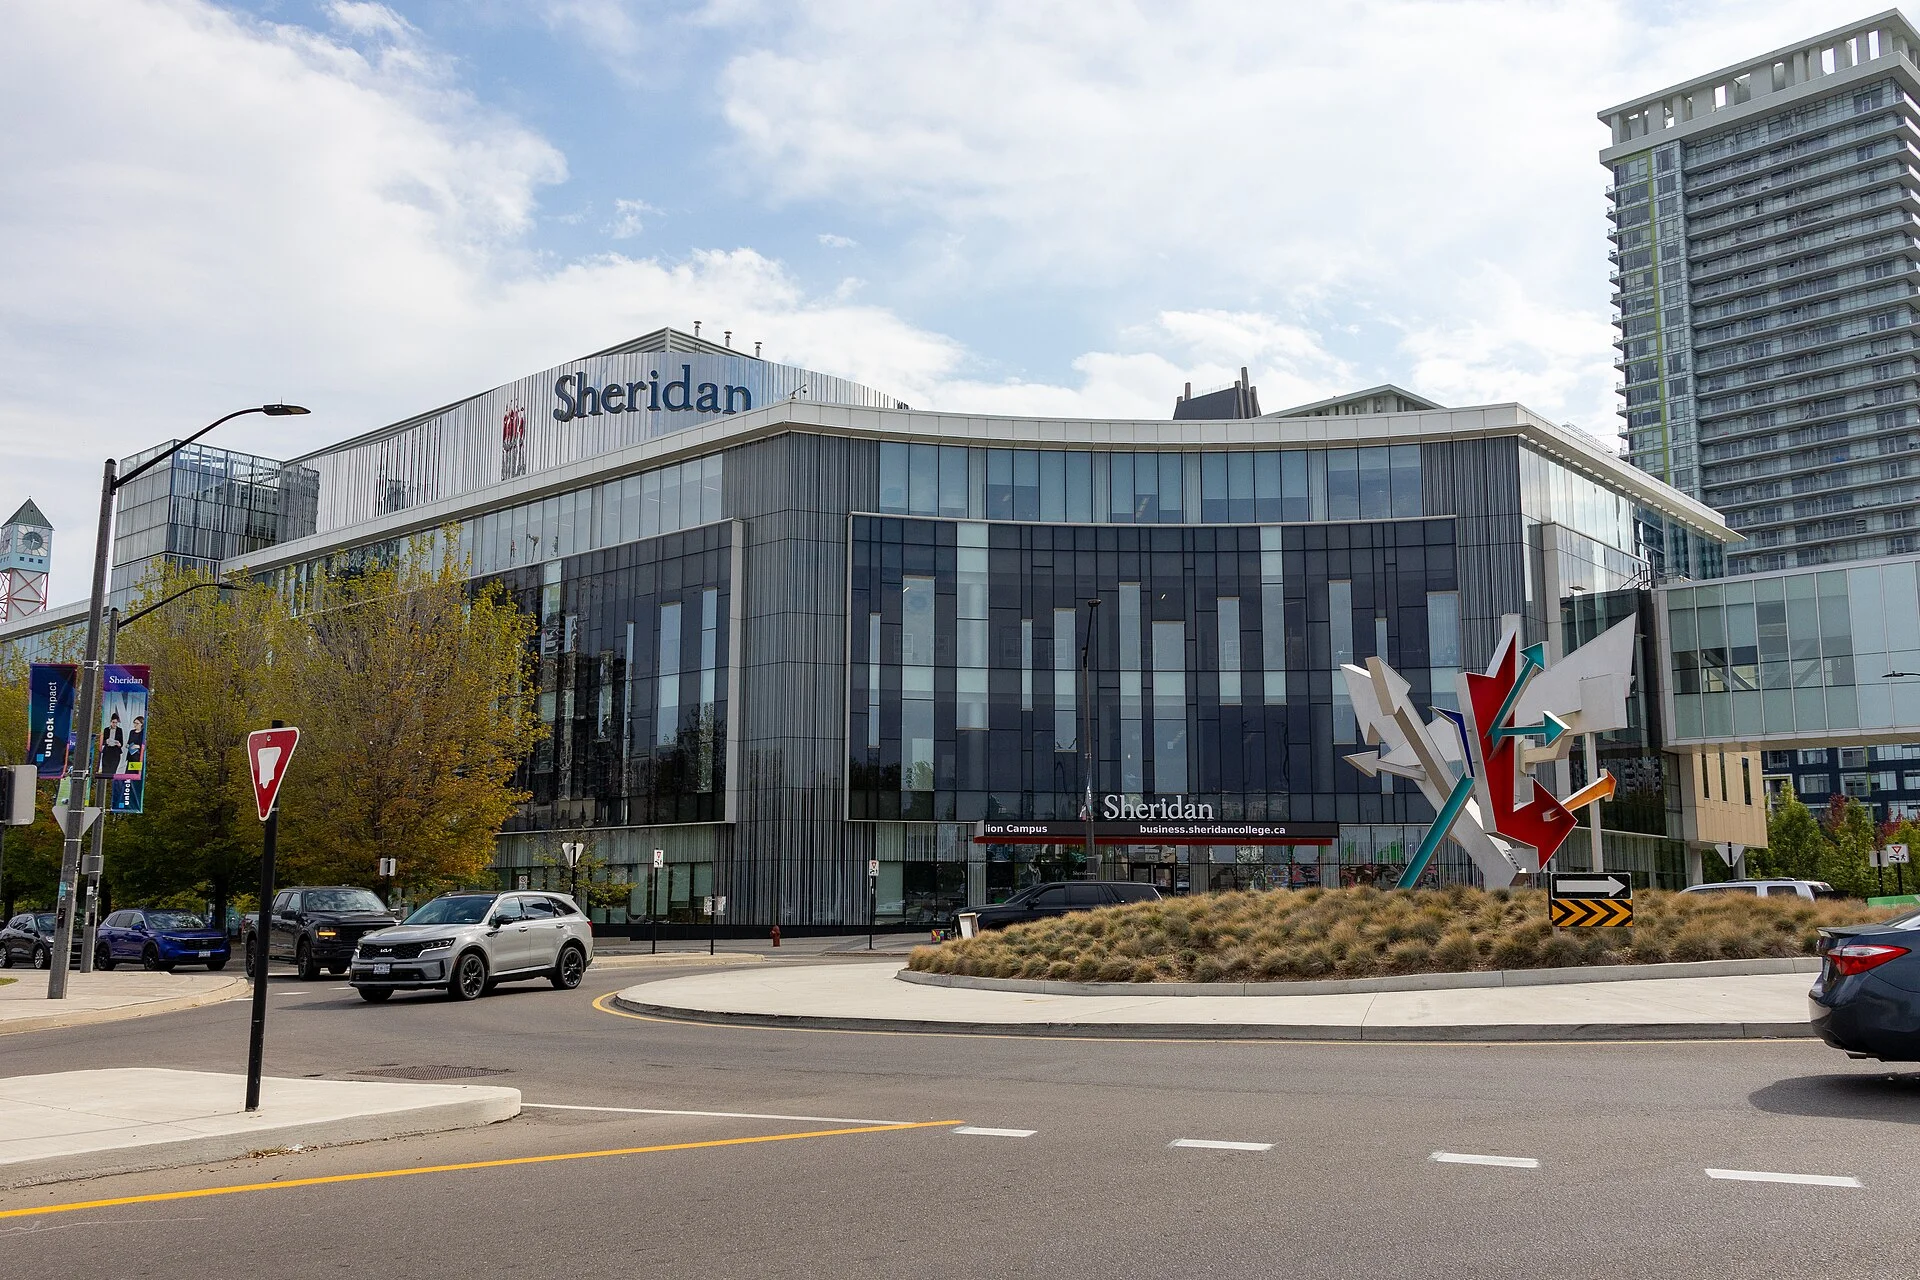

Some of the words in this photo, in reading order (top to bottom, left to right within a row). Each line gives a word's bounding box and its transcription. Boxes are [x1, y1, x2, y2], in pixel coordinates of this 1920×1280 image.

[553, 364, 752, 422] Sheridan
[109, 675, 143, 684] Sheridan
[47, 681, 58, 714] impact
[44, 717, 55, 758] unlock
[1103, 794, 1214, 819] Sheridan
[1006, 824, 1048, 835] Campus
[1139, 825, 1286, 836] business.sheridancollege.ca
